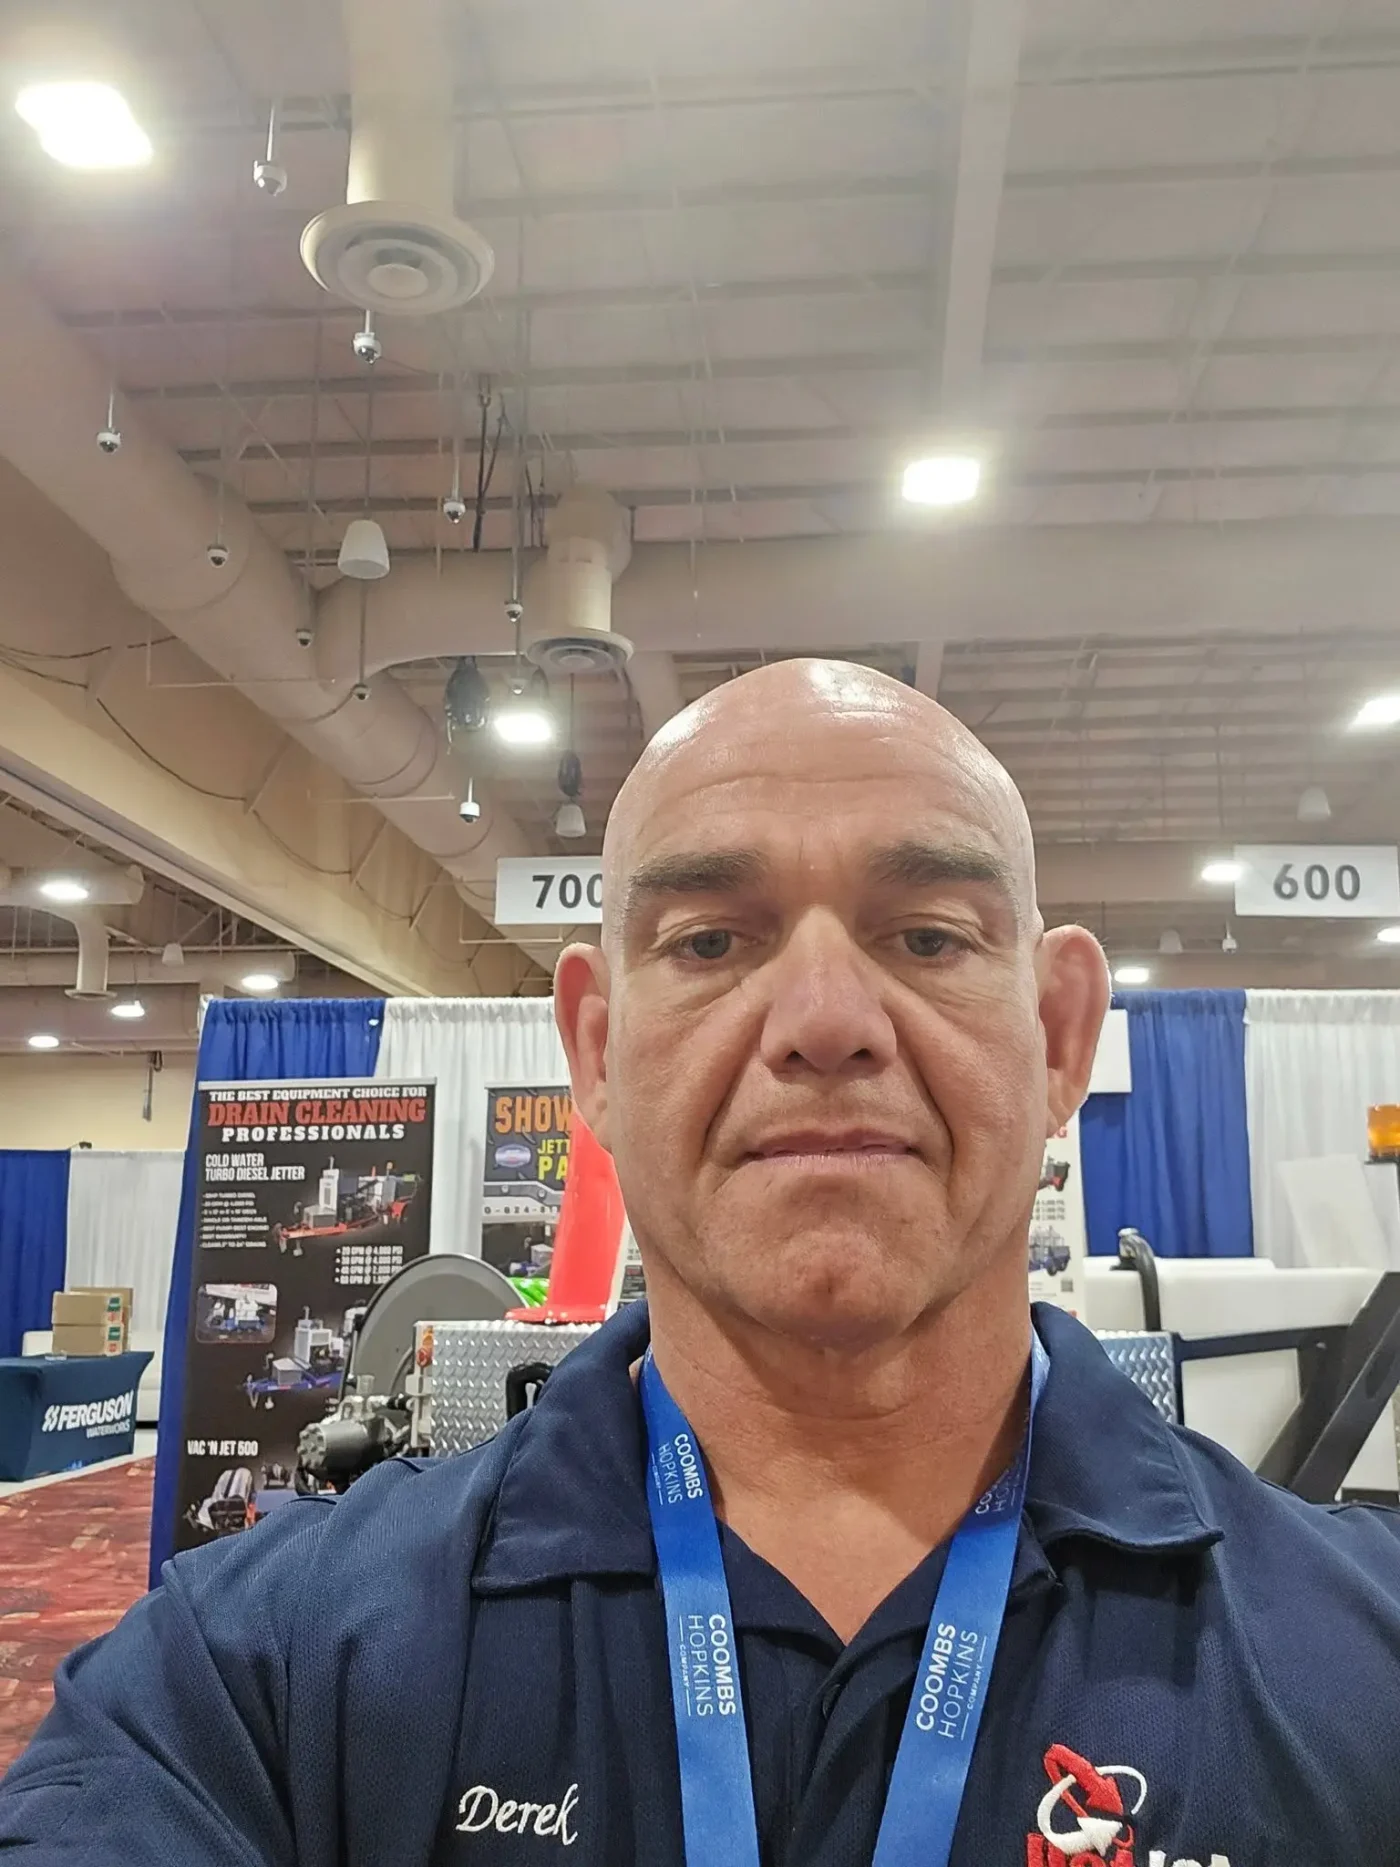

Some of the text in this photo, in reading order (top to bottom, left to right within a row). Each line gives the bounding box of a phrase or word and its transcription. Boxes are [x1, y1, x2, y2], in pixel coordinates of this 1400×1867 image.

[532, 873, 603, 910] 700
[1273, 863, 1361, 901] 600
[208, 1098, 426, 1126] DRAIN CLEANING
[209, 1086, 427, 1101] THE BEST EQUIPMENT CHOICE FOR
[222, 1124, 405, 1142] PROFESSIONALS
[205, 1152, 265, 1168] COLD WATER
[205, 1165, 305, 1182] TURBO DIESEL JETTER
[57, 1389, 134, 1431] FERGUSON
[187, 1440, 206, 1455] VAC
[219, 1440, 237, 1456] JET
[674, 1433, 704, 1499] COOMBS
[658, 1441, 683, 1504] HOPKINS
[680, 1644, 690, 1688] COMPANY
[688, 1614, 714, 1717] HOPKINS
[708, 1613, 737, 1716] COOMBS
[916, 1622, 956, 1731] COOMBS
[937, 1630, 978, 1738] HOPKINS
[966, 1663, 984, 1711] COMPANY
[455, 1783, 579, 1846] Derek
